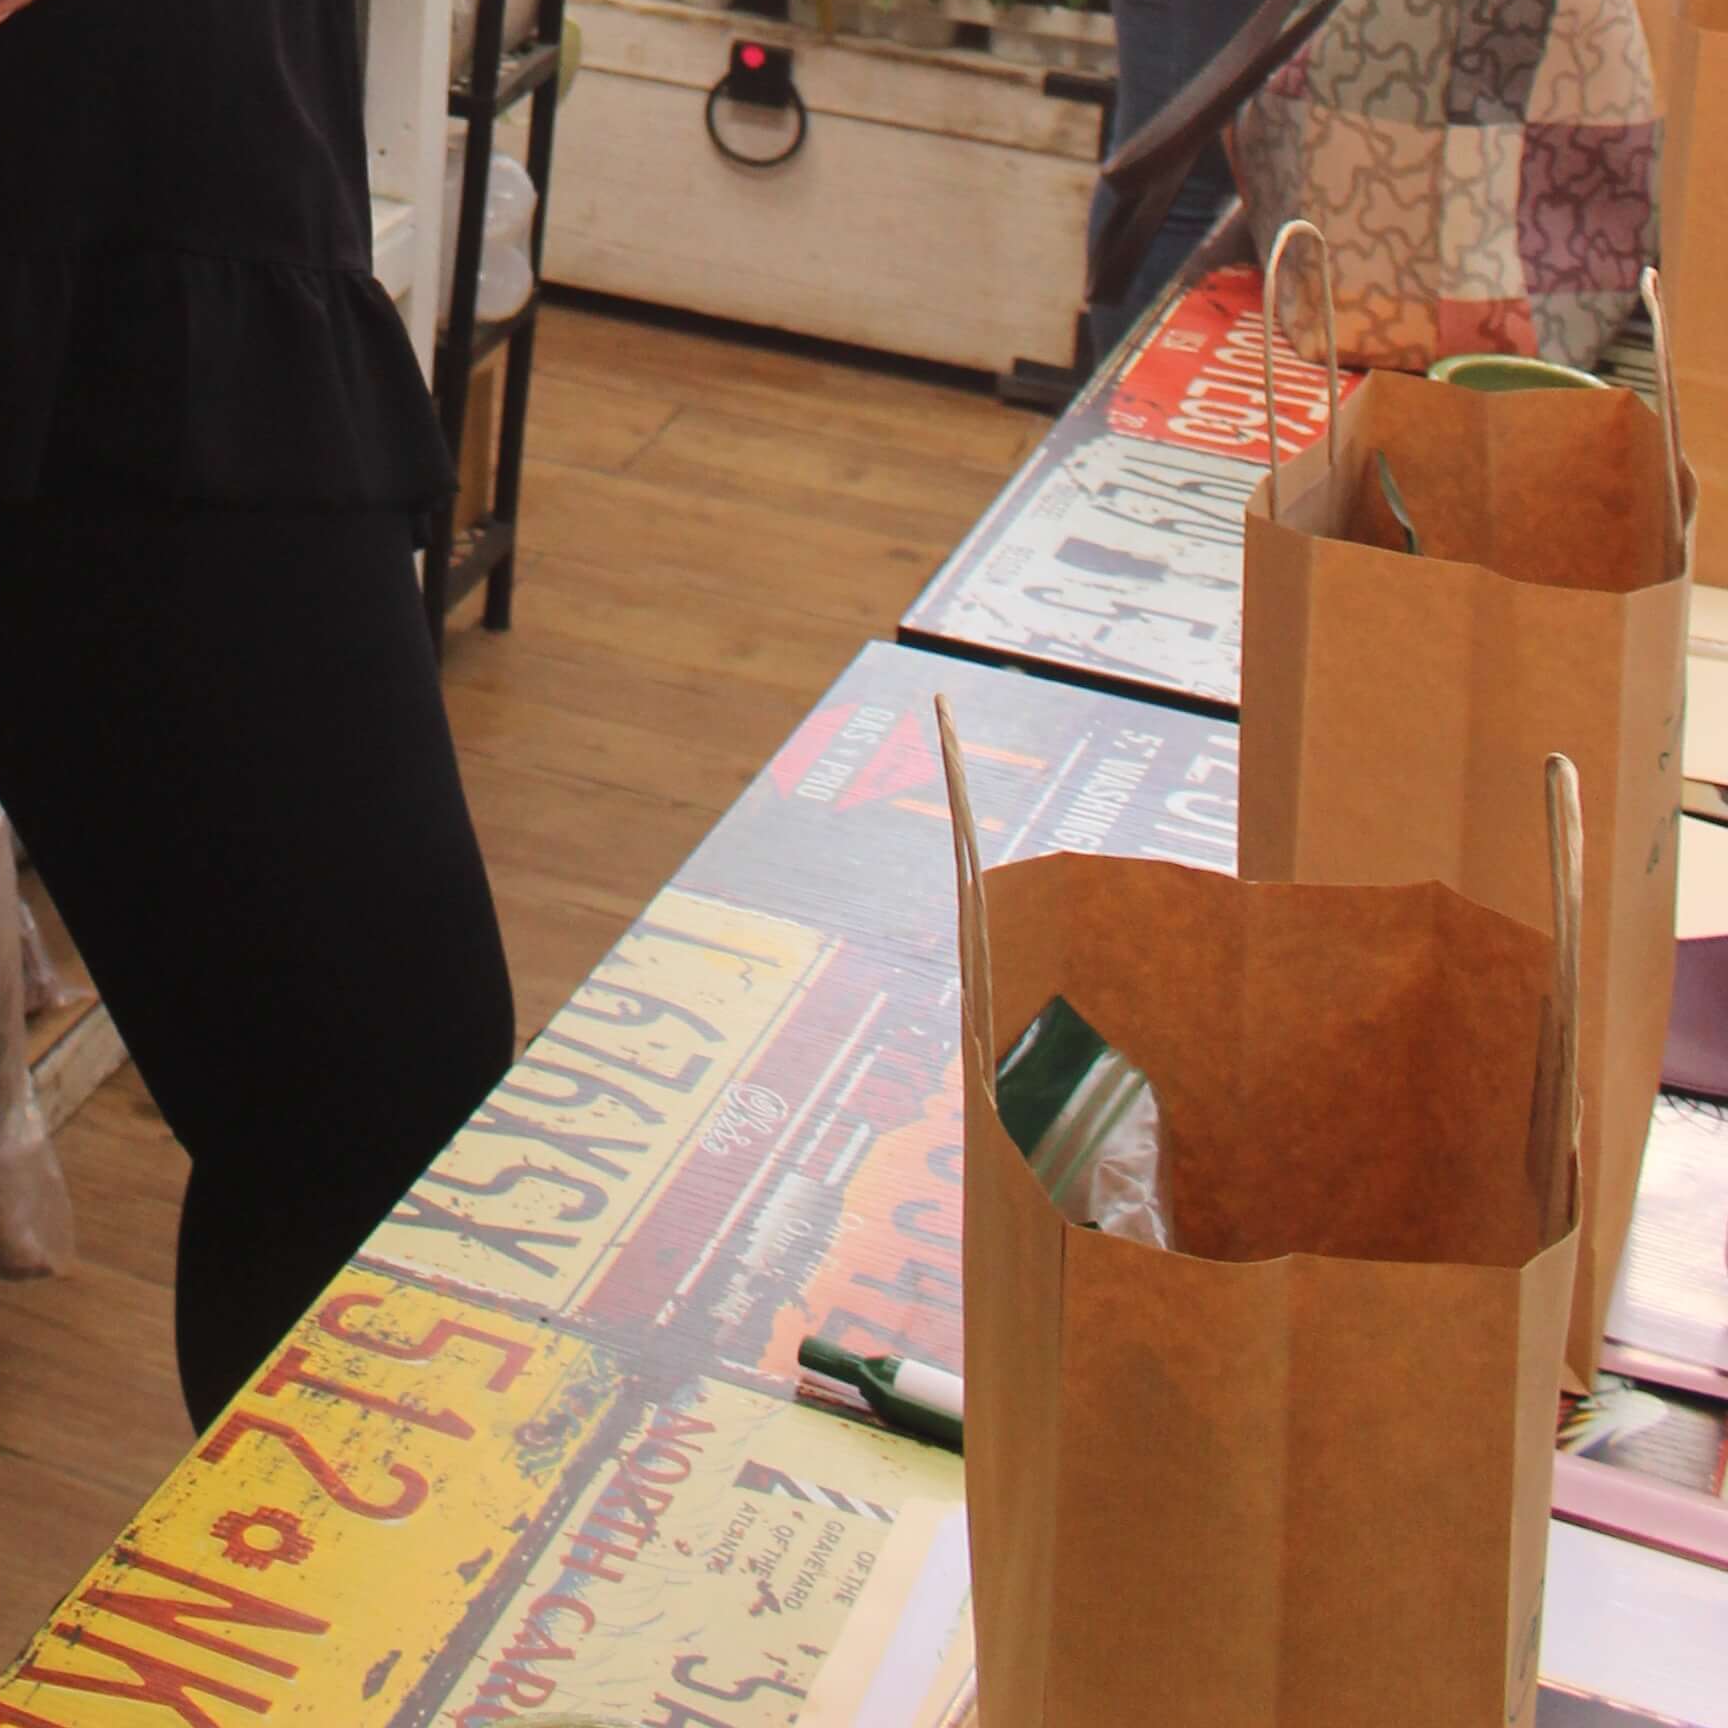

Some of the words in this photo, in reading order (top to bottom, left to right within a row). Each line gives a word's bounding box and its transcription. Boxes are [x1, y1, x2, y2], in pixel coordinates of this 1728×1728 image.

[841, 706, 896, 746] GAS
[795, 757, 856, 802] PRO
[1048, 757, 1149, 853] WASHING
[700, 1080, 788, 1156] Ohio
[198, 1292, 536, 1522] 512
[559, 1408, 716, 1583] NORTH
[770, 1525, 796, 1552] OF
[784, 1520, 846, 1611] GRAVEYARD
[855, 1550, 878, 1577] OF
[833, 1569, 862, 1608] THE
